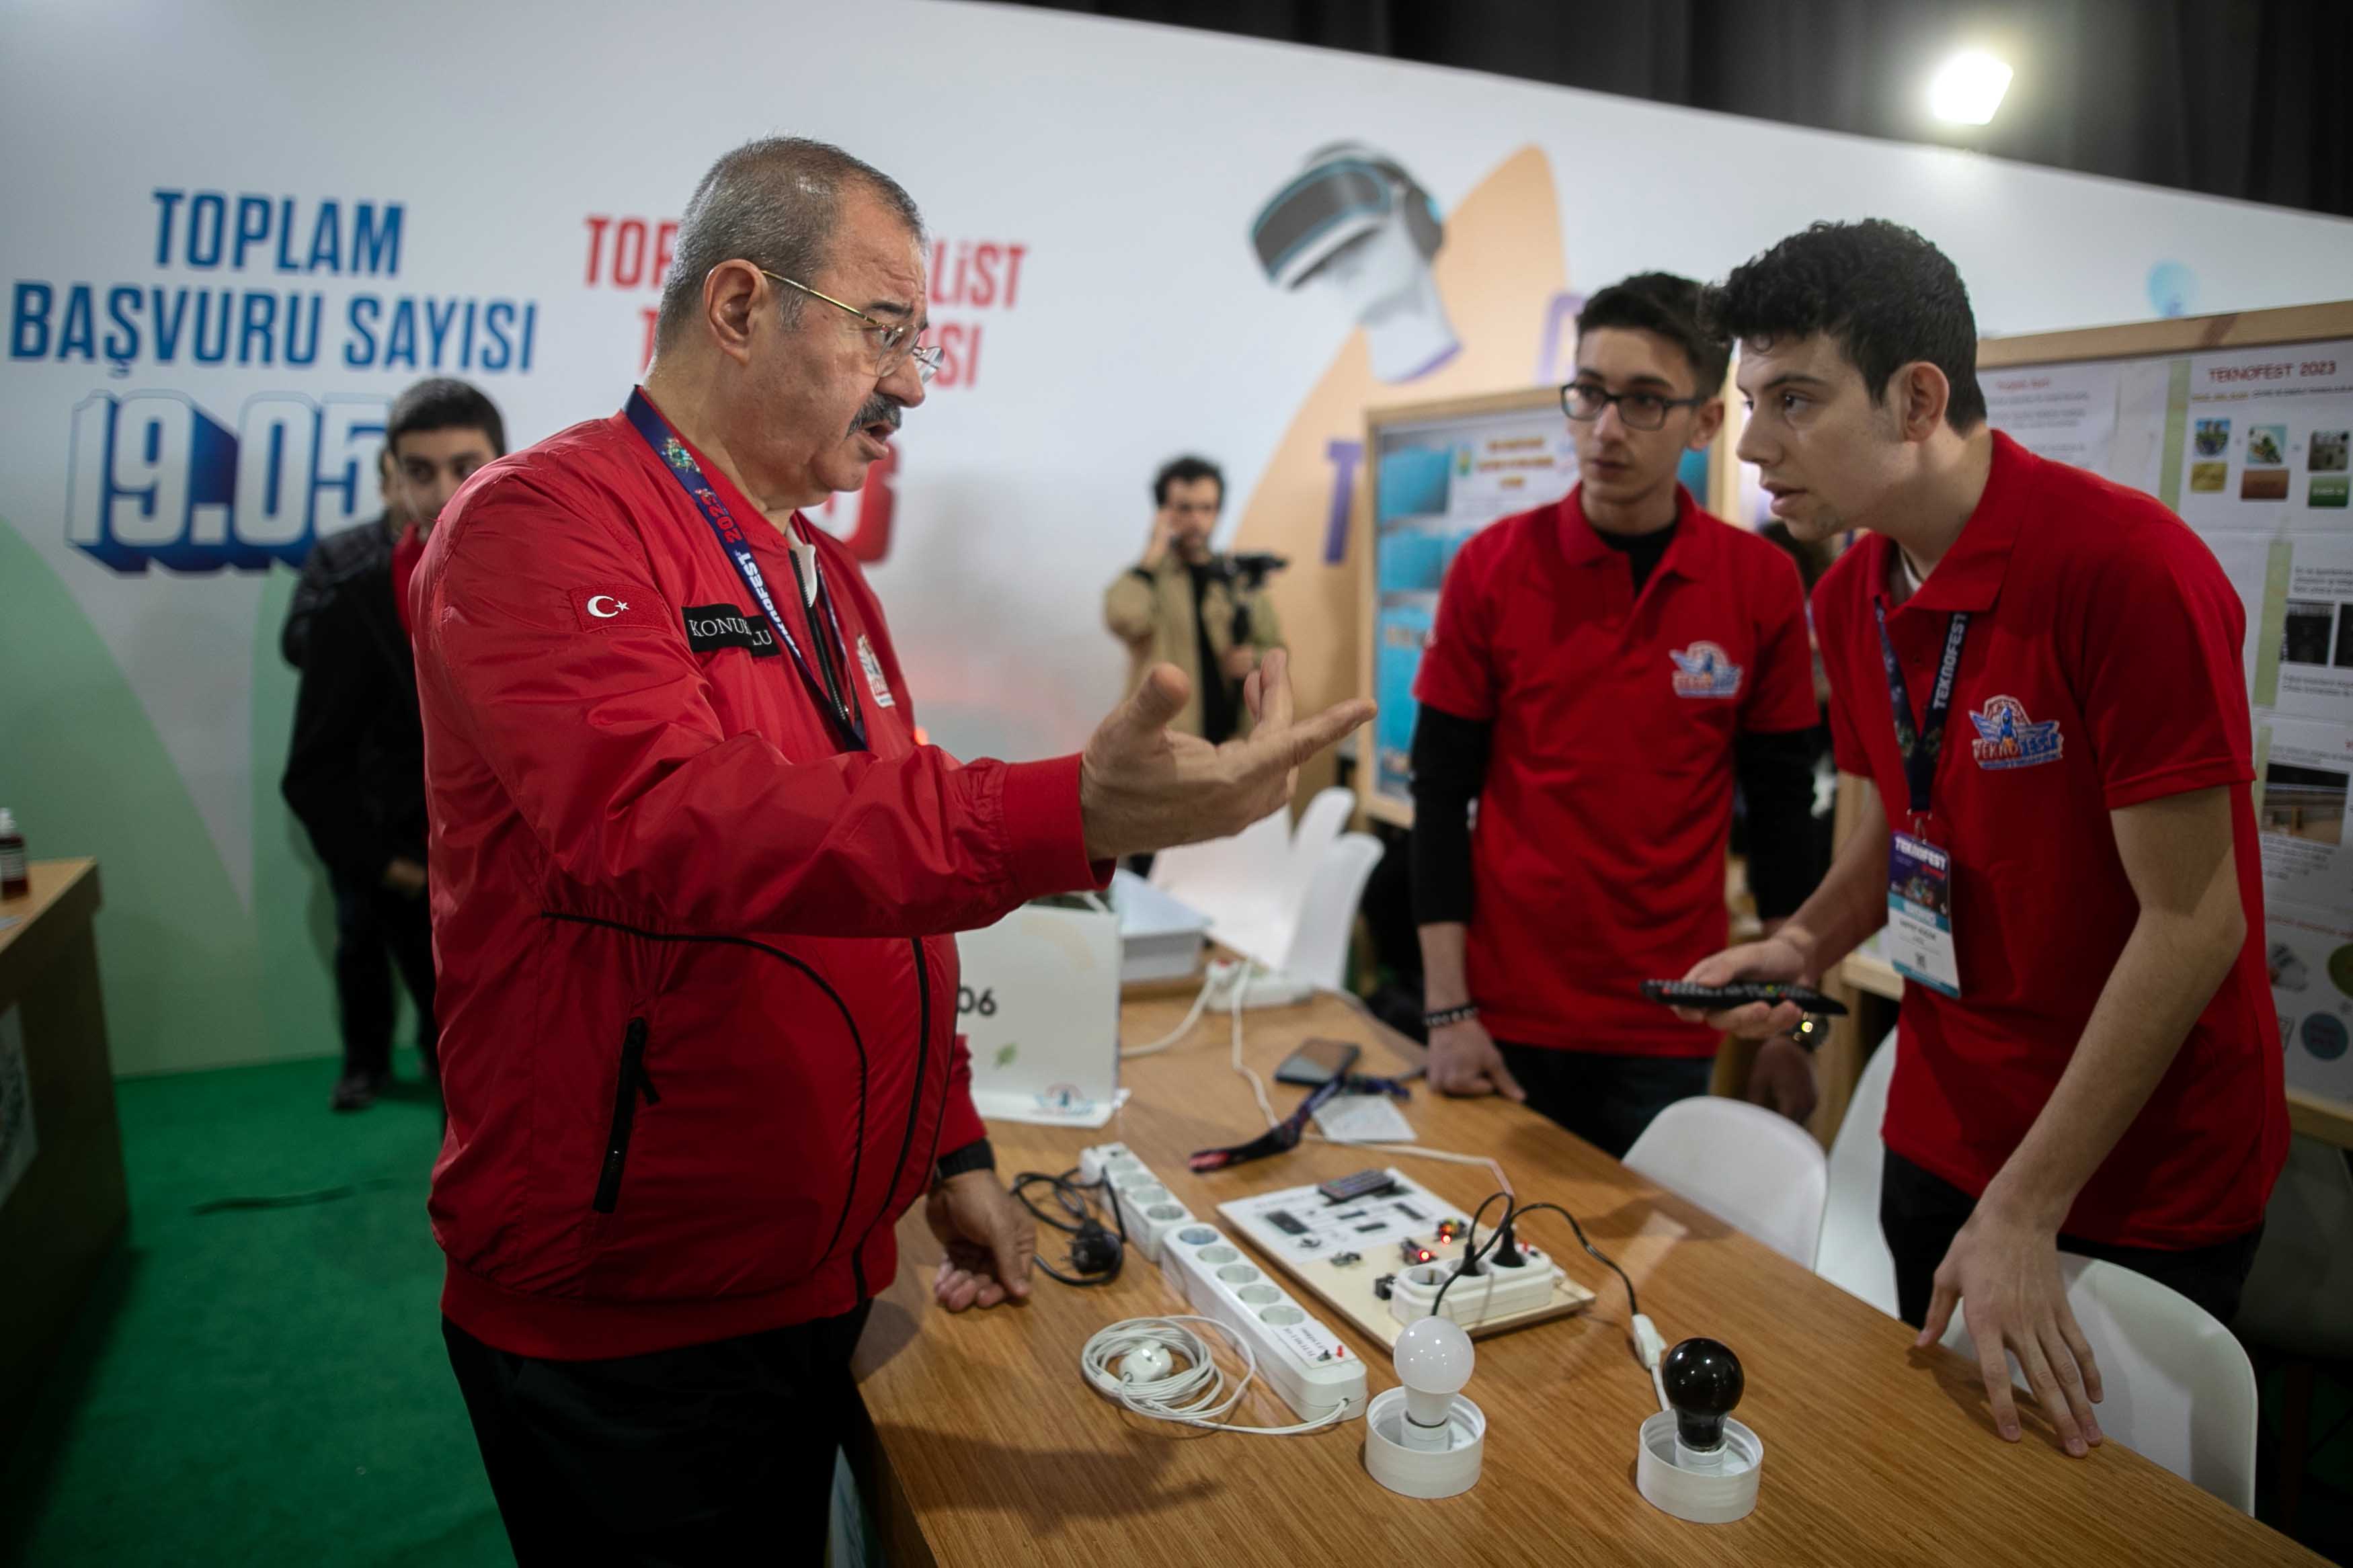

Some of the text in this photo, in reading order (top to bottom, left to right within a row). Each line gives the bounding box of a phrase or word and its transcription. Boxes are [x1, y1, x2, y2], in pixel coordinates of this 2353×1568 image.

[152, 188, 405, 276] TOPLAM
[584, 216, 678, 288] TOP
[9, 282, 326, 378] BAŞVURU
[343, 294, 538, 373] SAYISI
[2209, 360, 2337, 382] TEKNOFEST 2023
[67, 388, 388, 570] 19.05
